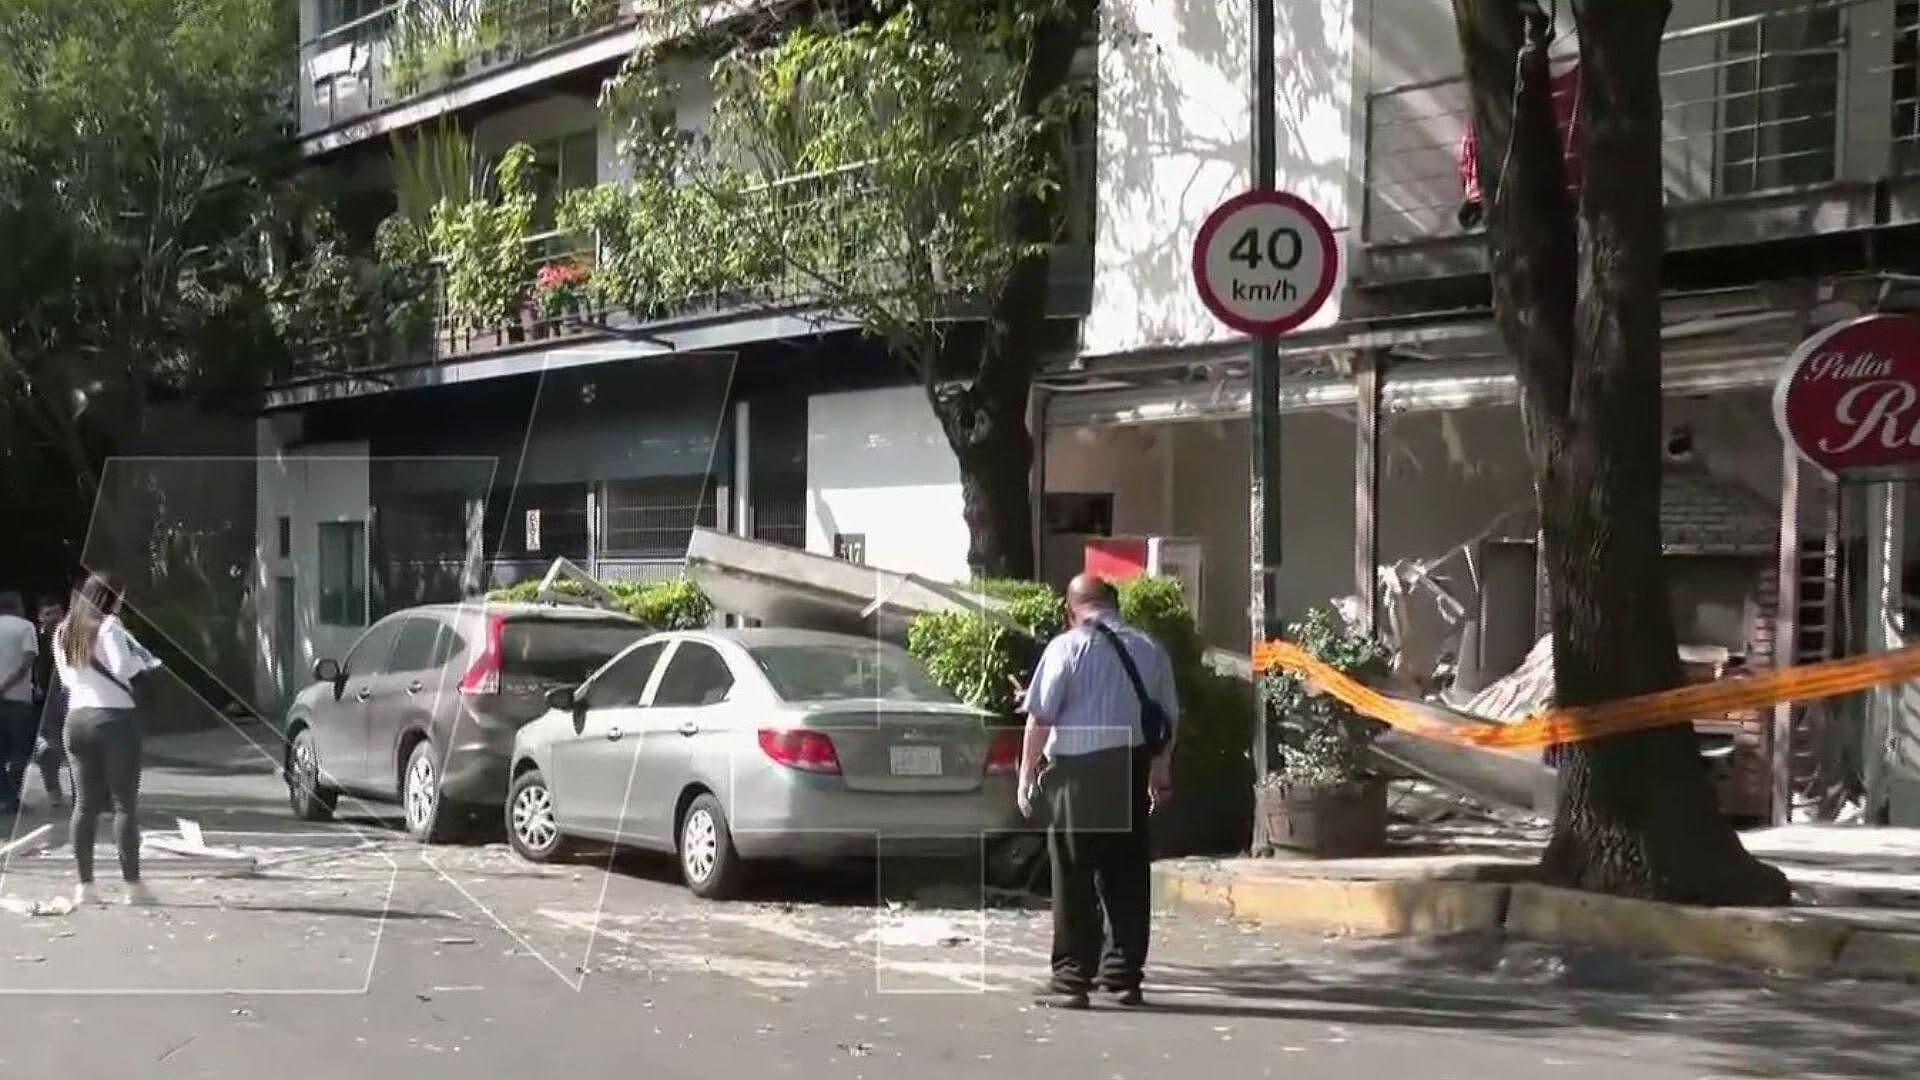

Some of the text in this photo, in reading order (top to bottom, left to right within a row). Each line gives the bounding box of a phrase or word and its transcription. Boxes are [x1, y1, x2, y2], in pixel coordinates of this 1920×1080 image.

[1229, 227, 1303, 270] 40
[1232, 278, 1298, 301] km/h
[1804, 352, 1893, 383] Pollos
